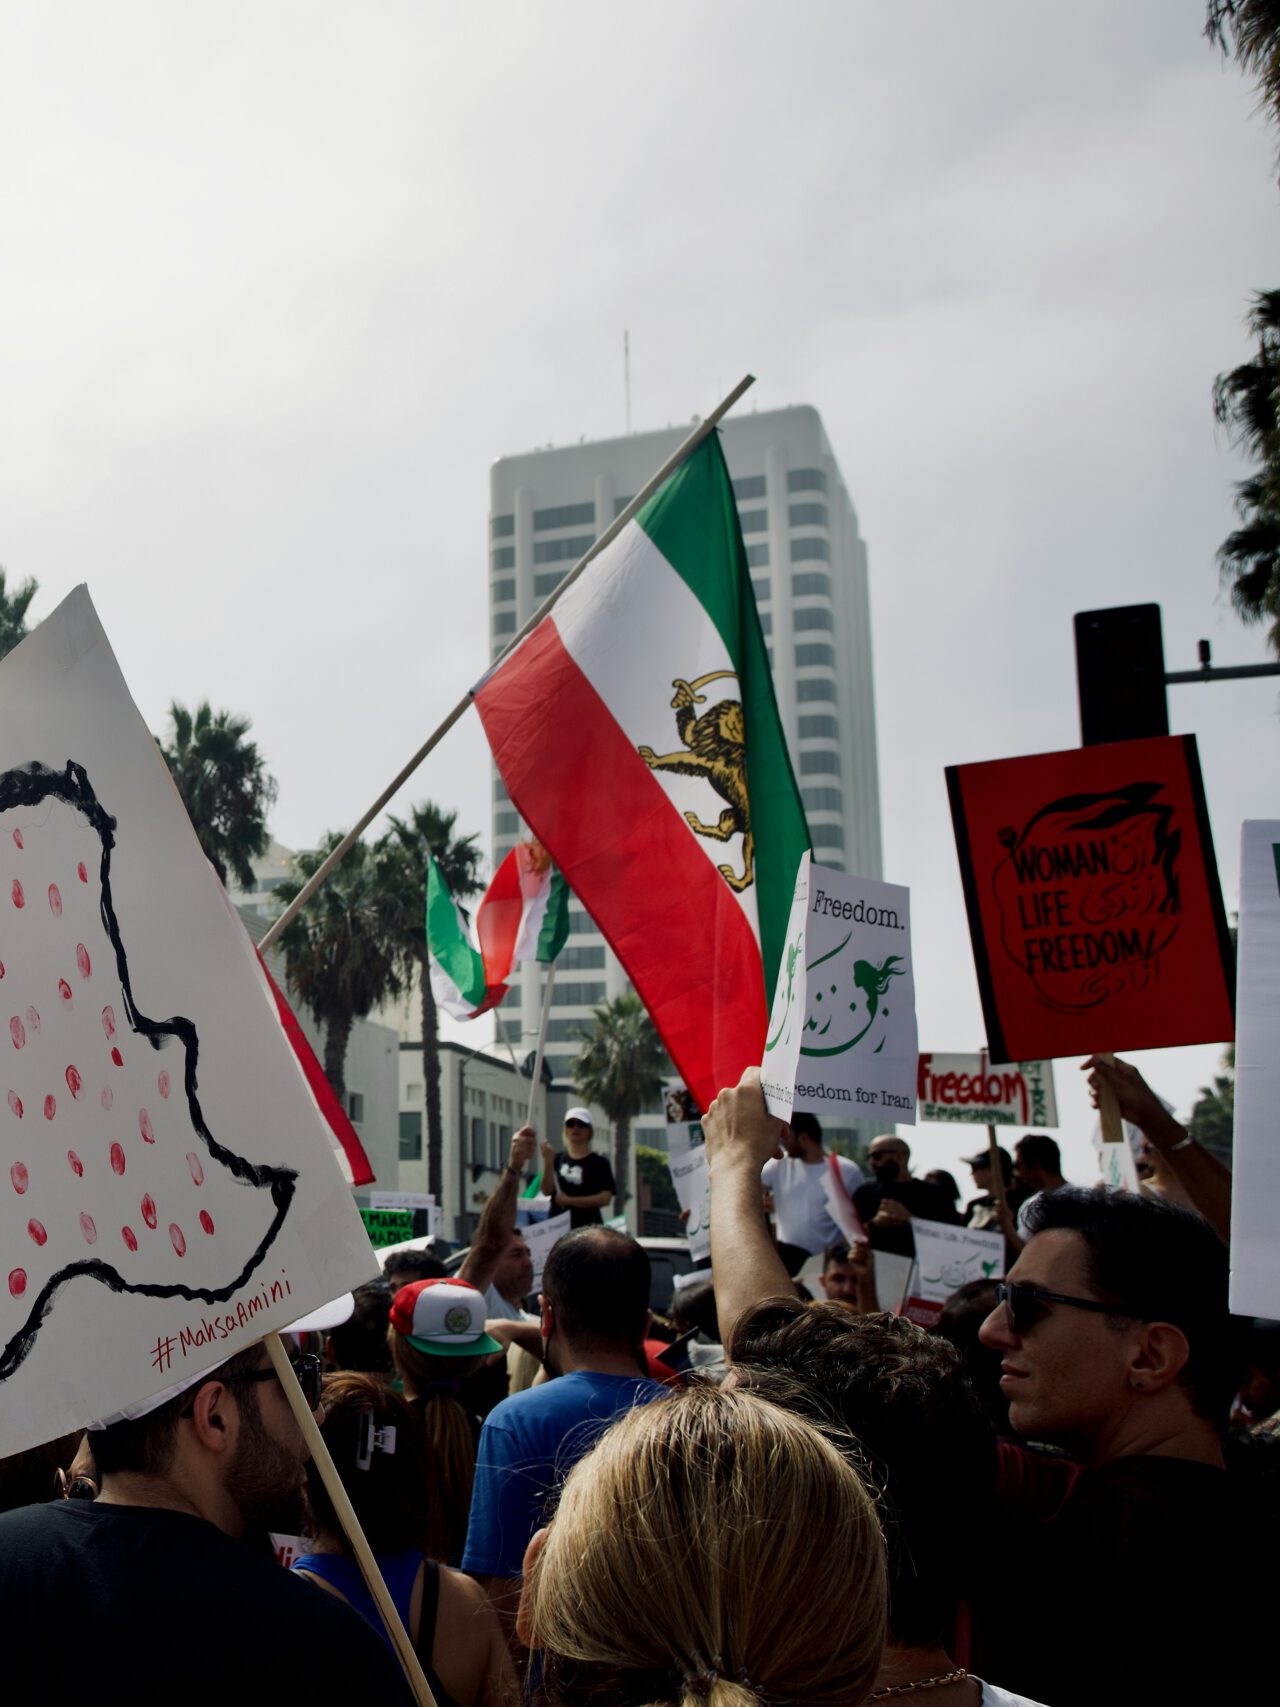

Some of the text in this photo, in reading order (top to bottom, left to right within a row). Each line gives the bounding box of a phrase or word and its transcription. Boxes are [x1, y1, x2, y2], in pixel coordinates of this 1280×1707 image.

[1012, 839, 1109, 885] WOMAN
[812, 889, 906, 931] Freedom.
[1018, 890, 1073, 931] LIFE
[794, 1083, 853, 1104] eedom
[855, 1087, 878, 1105] for
[881, 1091, 913, 1110] Iran.
[150, 1268, 292, 1374] #MahsaAmini
